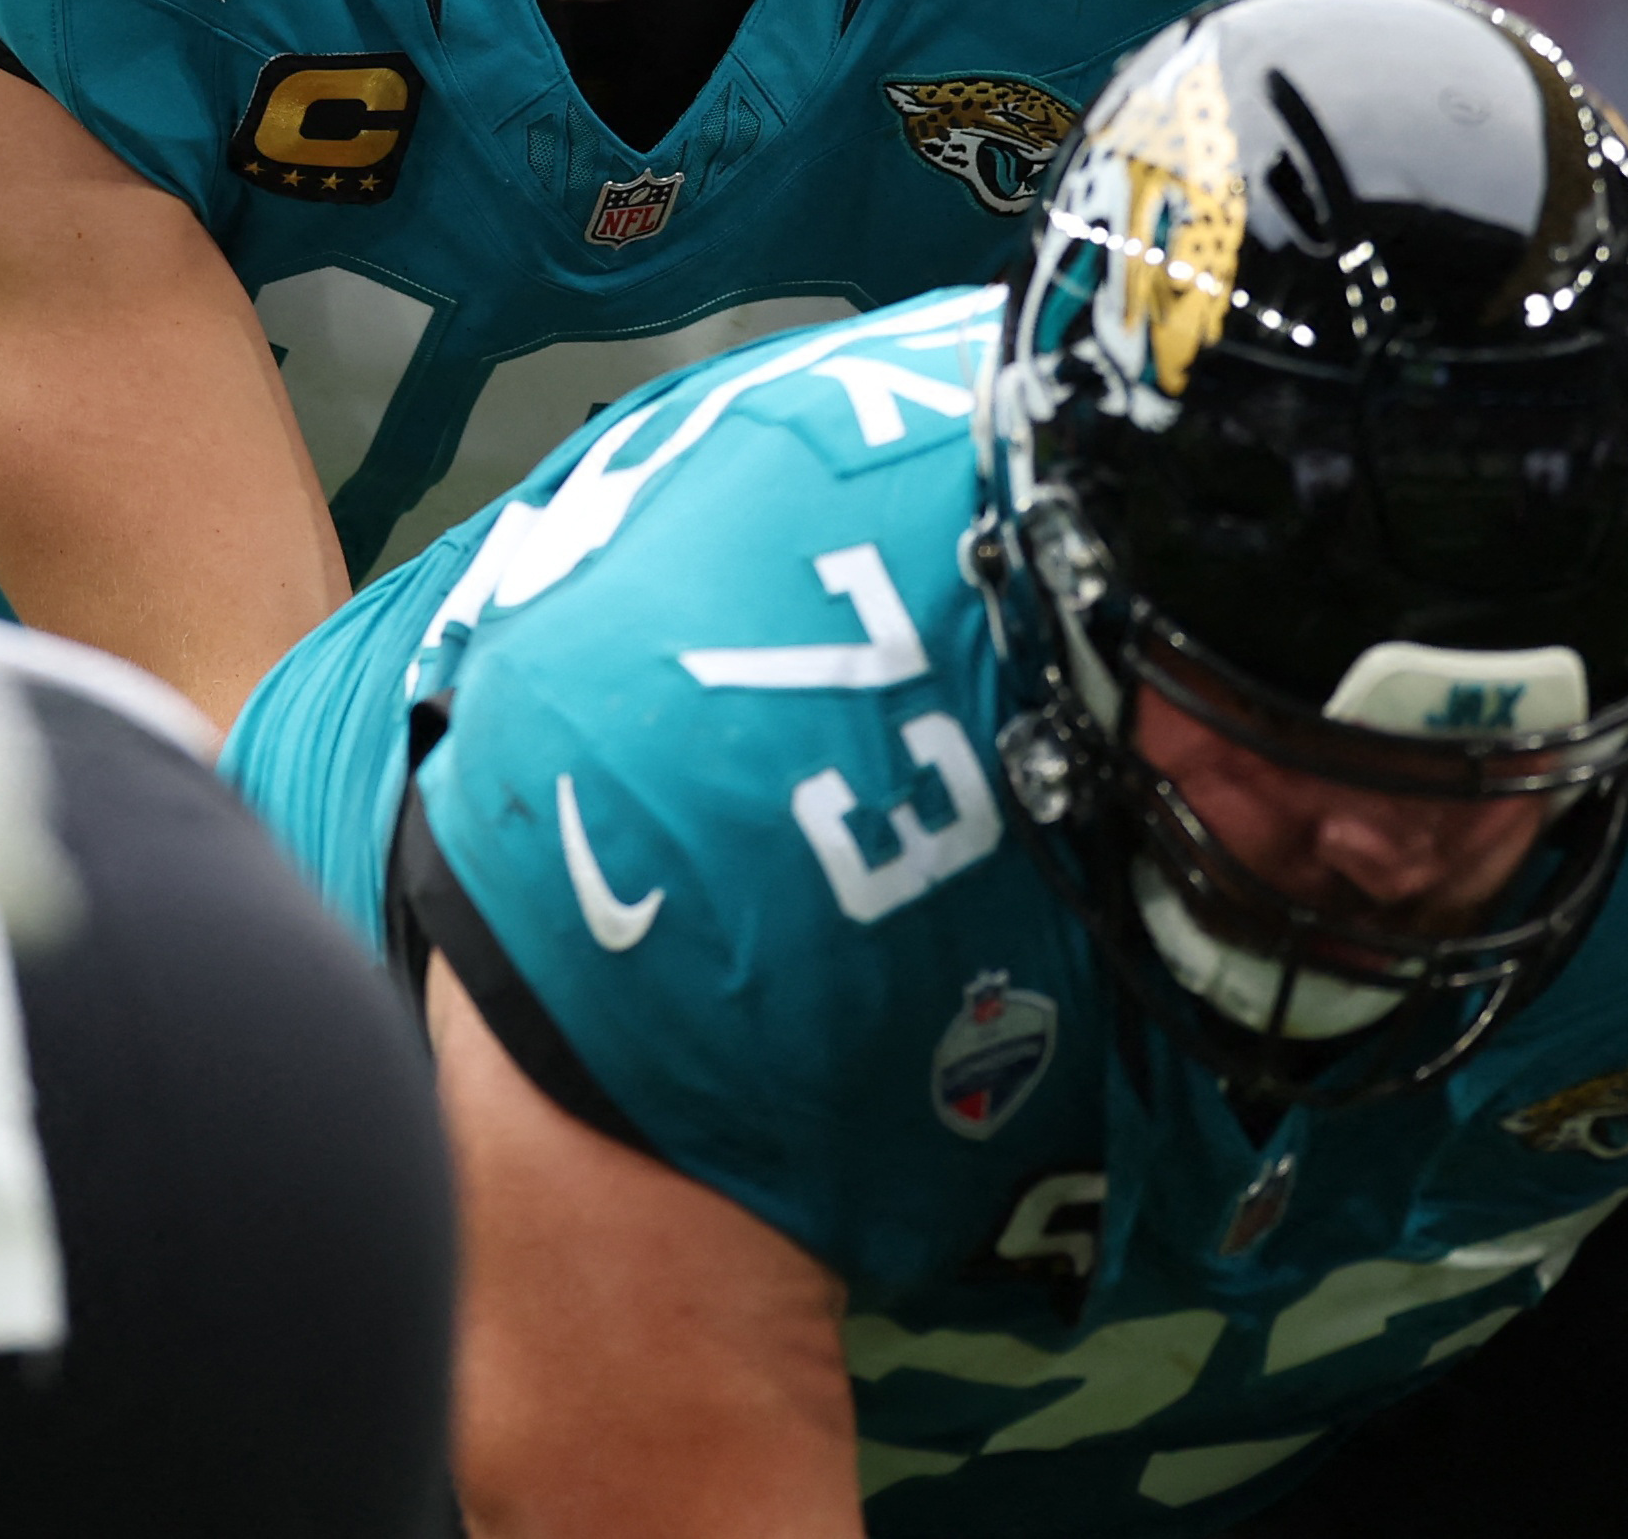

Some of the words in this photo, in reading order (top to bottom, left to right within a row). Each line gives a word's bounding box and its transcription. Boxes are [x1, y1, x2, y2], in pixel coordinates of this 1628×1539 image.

[253, 67, 409, 168] C
[597, 205, 656, 238] NFL
[678, 540, 1004, 924] 73
